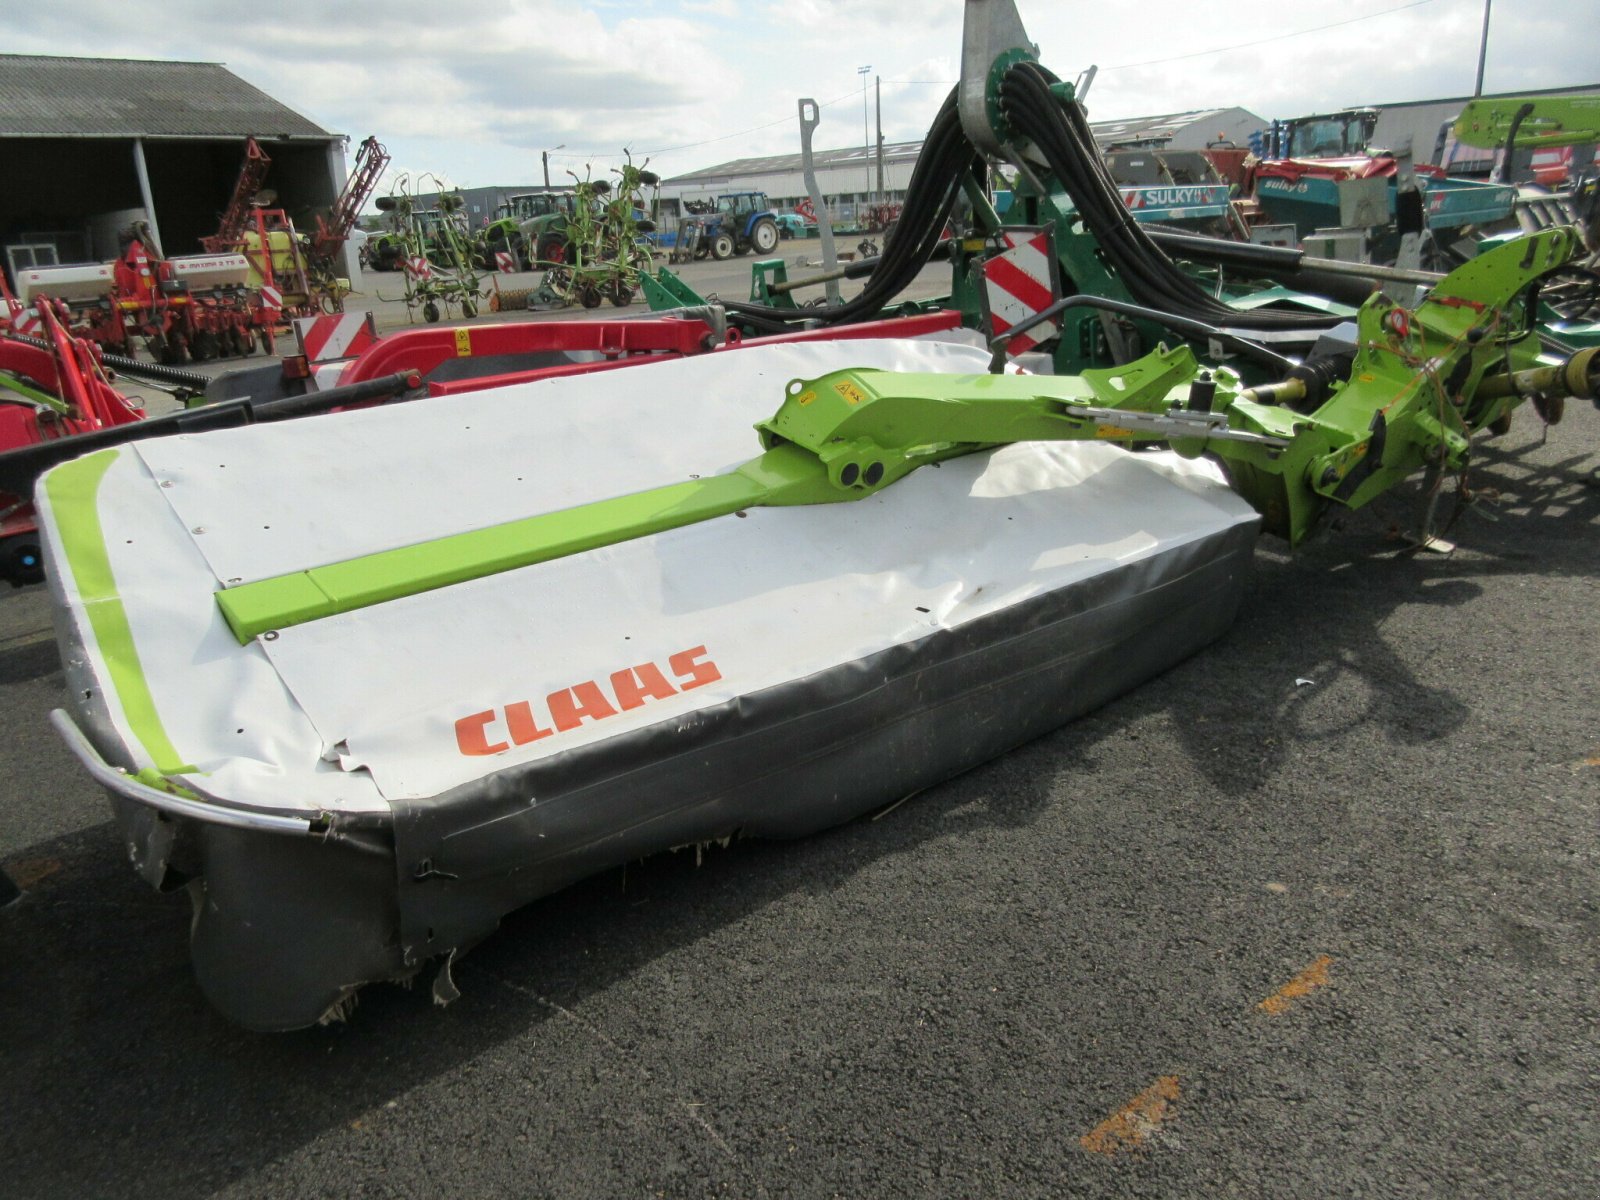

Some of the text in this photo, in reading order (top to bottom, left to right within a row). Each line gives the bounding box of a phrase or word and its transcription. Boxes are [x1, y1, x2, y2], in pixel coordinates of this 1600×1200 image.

[1265, 180, 1297, 192] sulky
[1146, 189, 1194, 206] SULKY
[189, 261, 217, 269] MAXIMA
[455, 645, 722, 756] CLAAS
